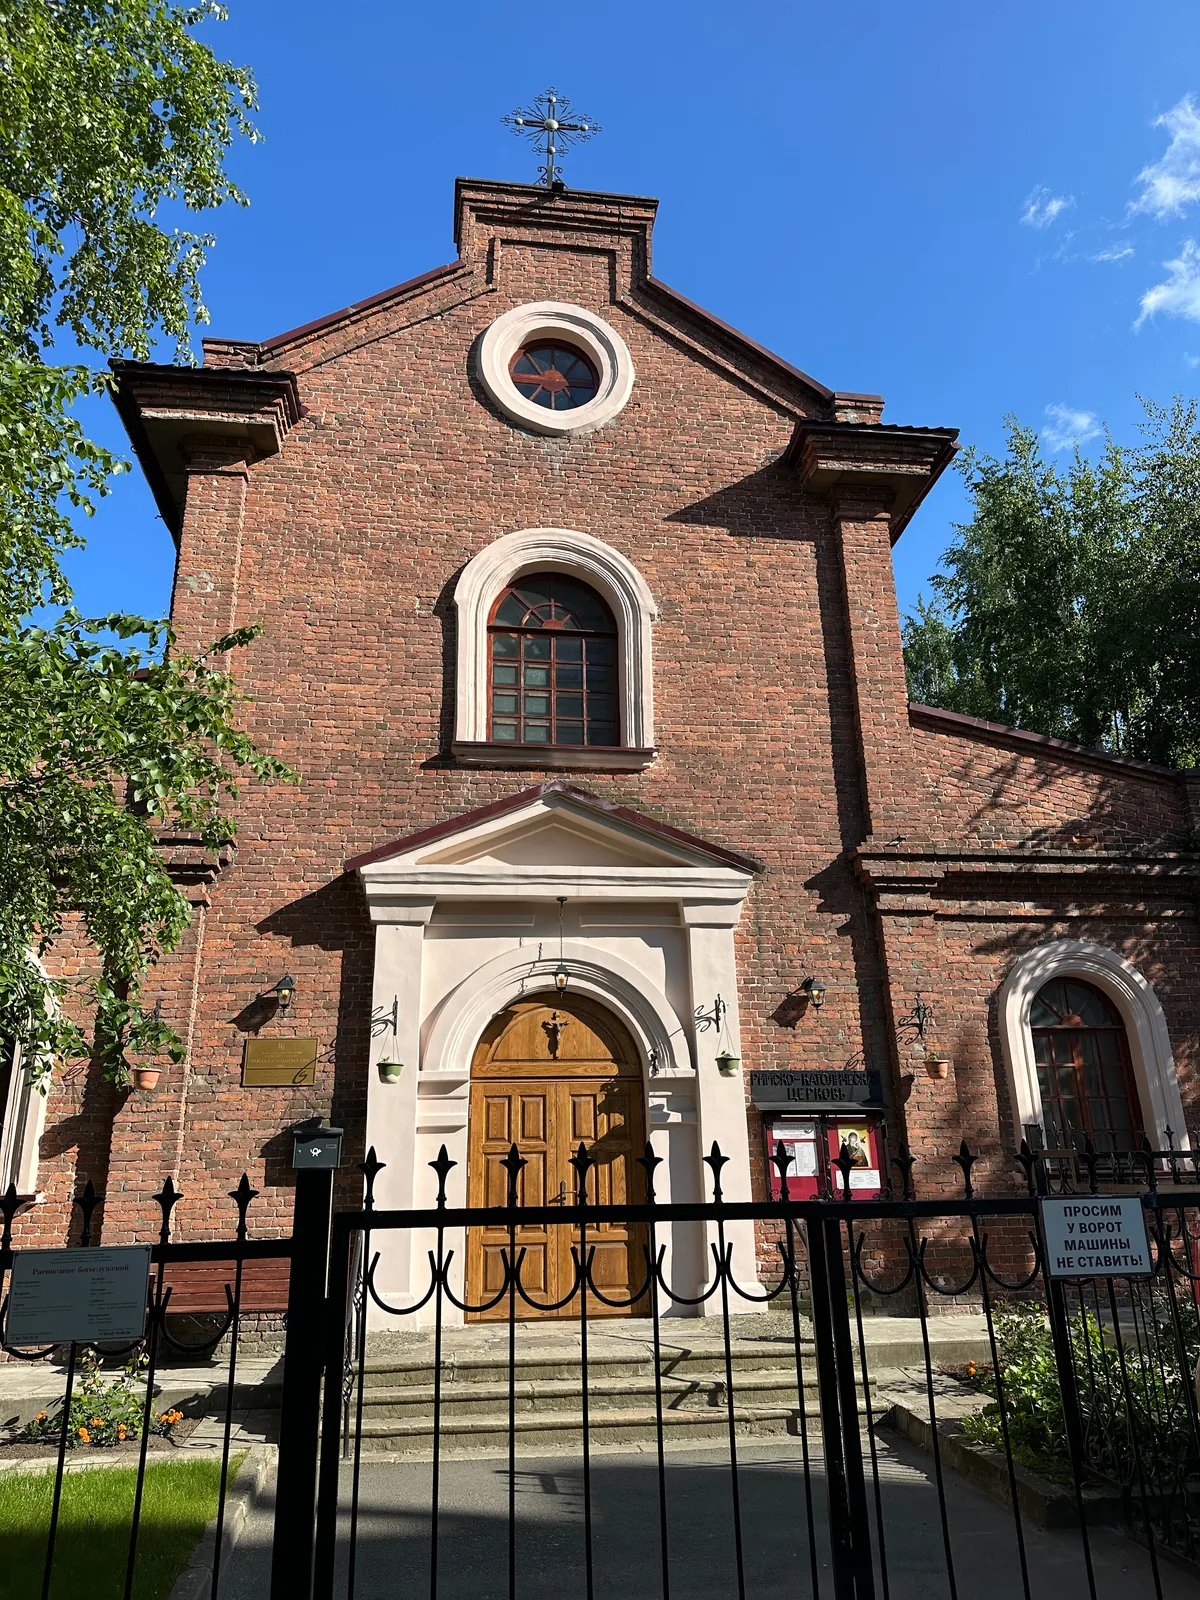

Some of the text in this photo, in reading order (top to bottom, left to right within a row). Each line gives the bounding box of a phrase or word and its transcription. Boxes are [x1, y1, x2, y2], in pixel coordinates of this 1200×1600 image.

[750, 1072, 881, 1087] РИМСКО-КАТОЛИЧЕСК
[787, 1087, 846, 1102] ЦЕРКОВЬ
[1063, 1205, 1122, 1217] ПРОСИМ
[1067, 1222, 1122, 1233] У ВОРОТ
[1064, 1238, 1131, 1251] МАШИНЫ
[1056, 1255, 1143, 1268] НЕ СТАВИТЬ!
